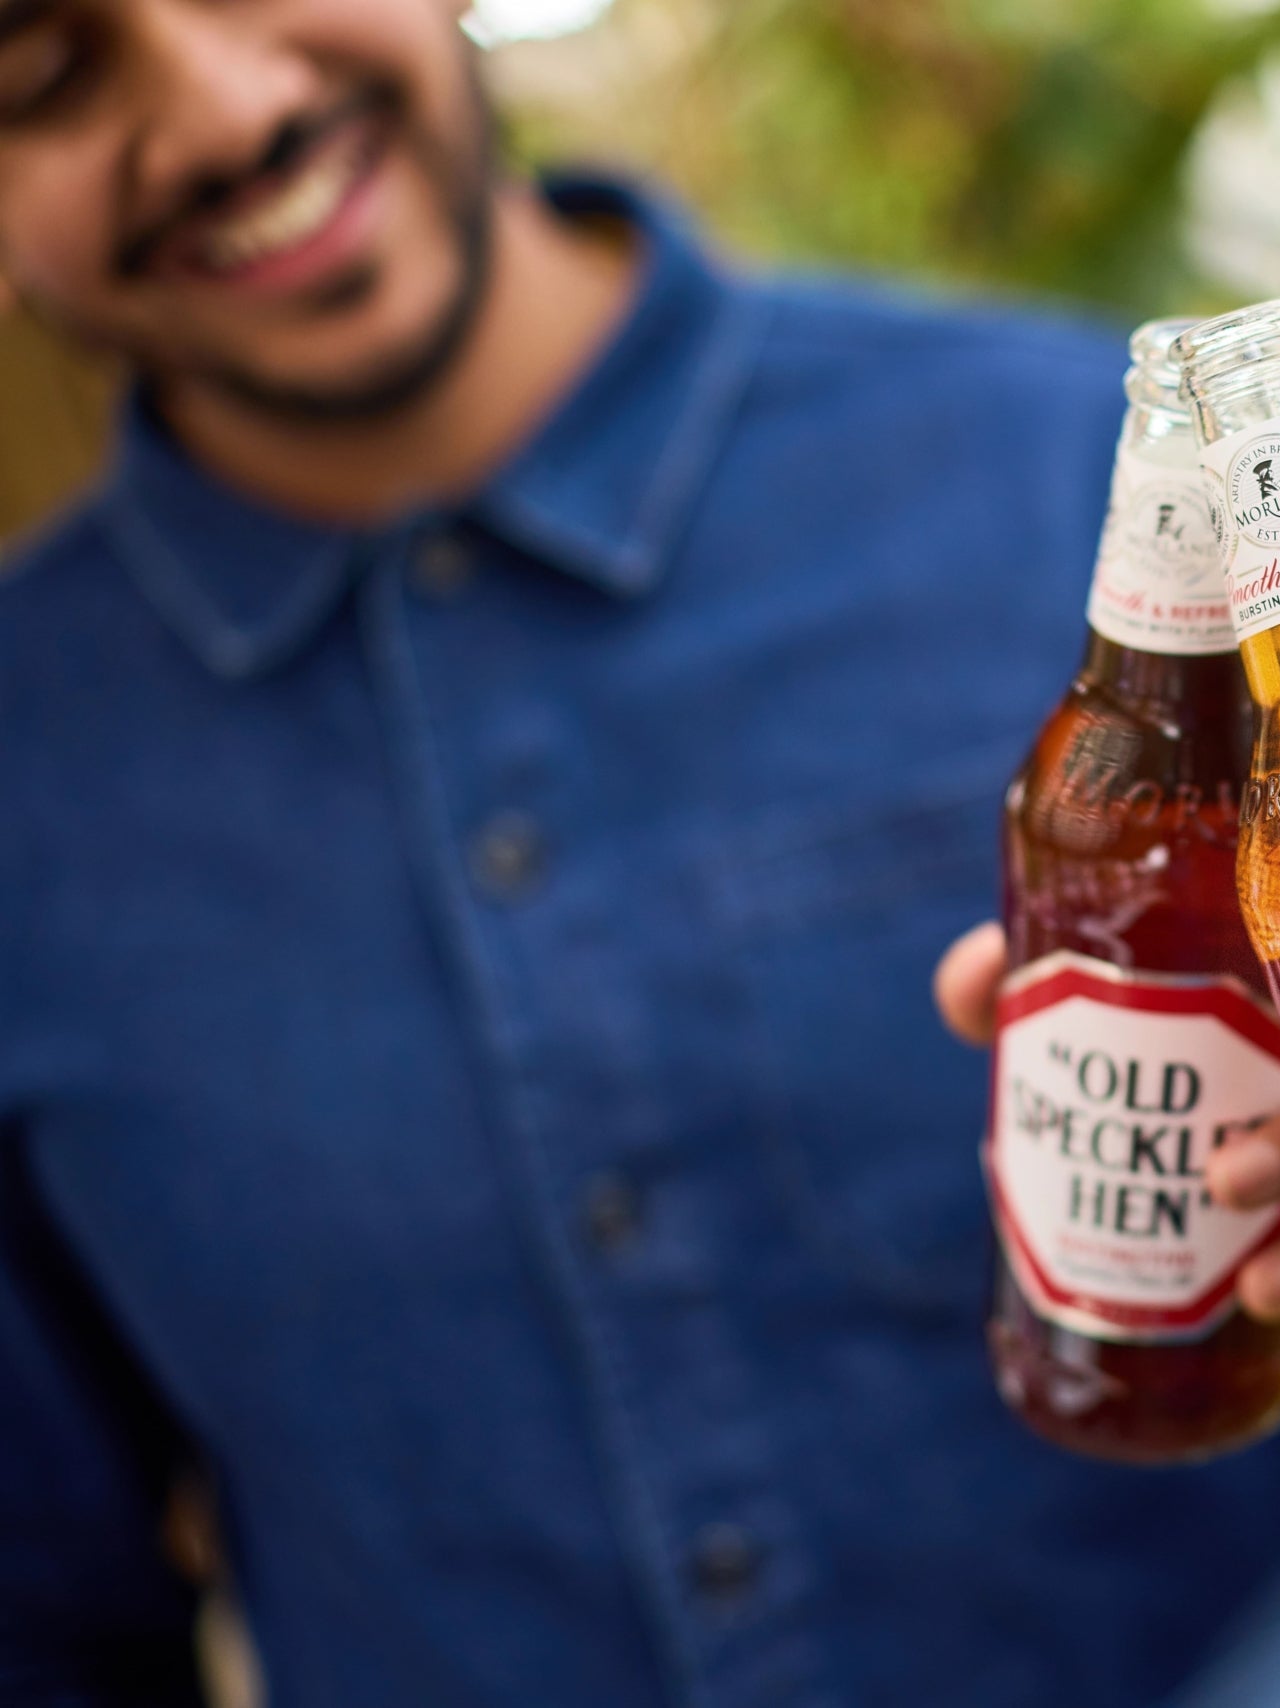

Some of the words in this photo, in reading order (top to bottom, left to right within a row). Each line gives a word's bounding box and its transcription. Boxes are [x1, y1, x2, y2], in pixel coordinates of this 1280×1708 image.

[1232, 453, 1252, 504] ARTISTRY
[1253, 446, 1267, 459] IN
[1013, 1077, 1260, 1178] SPECKL
